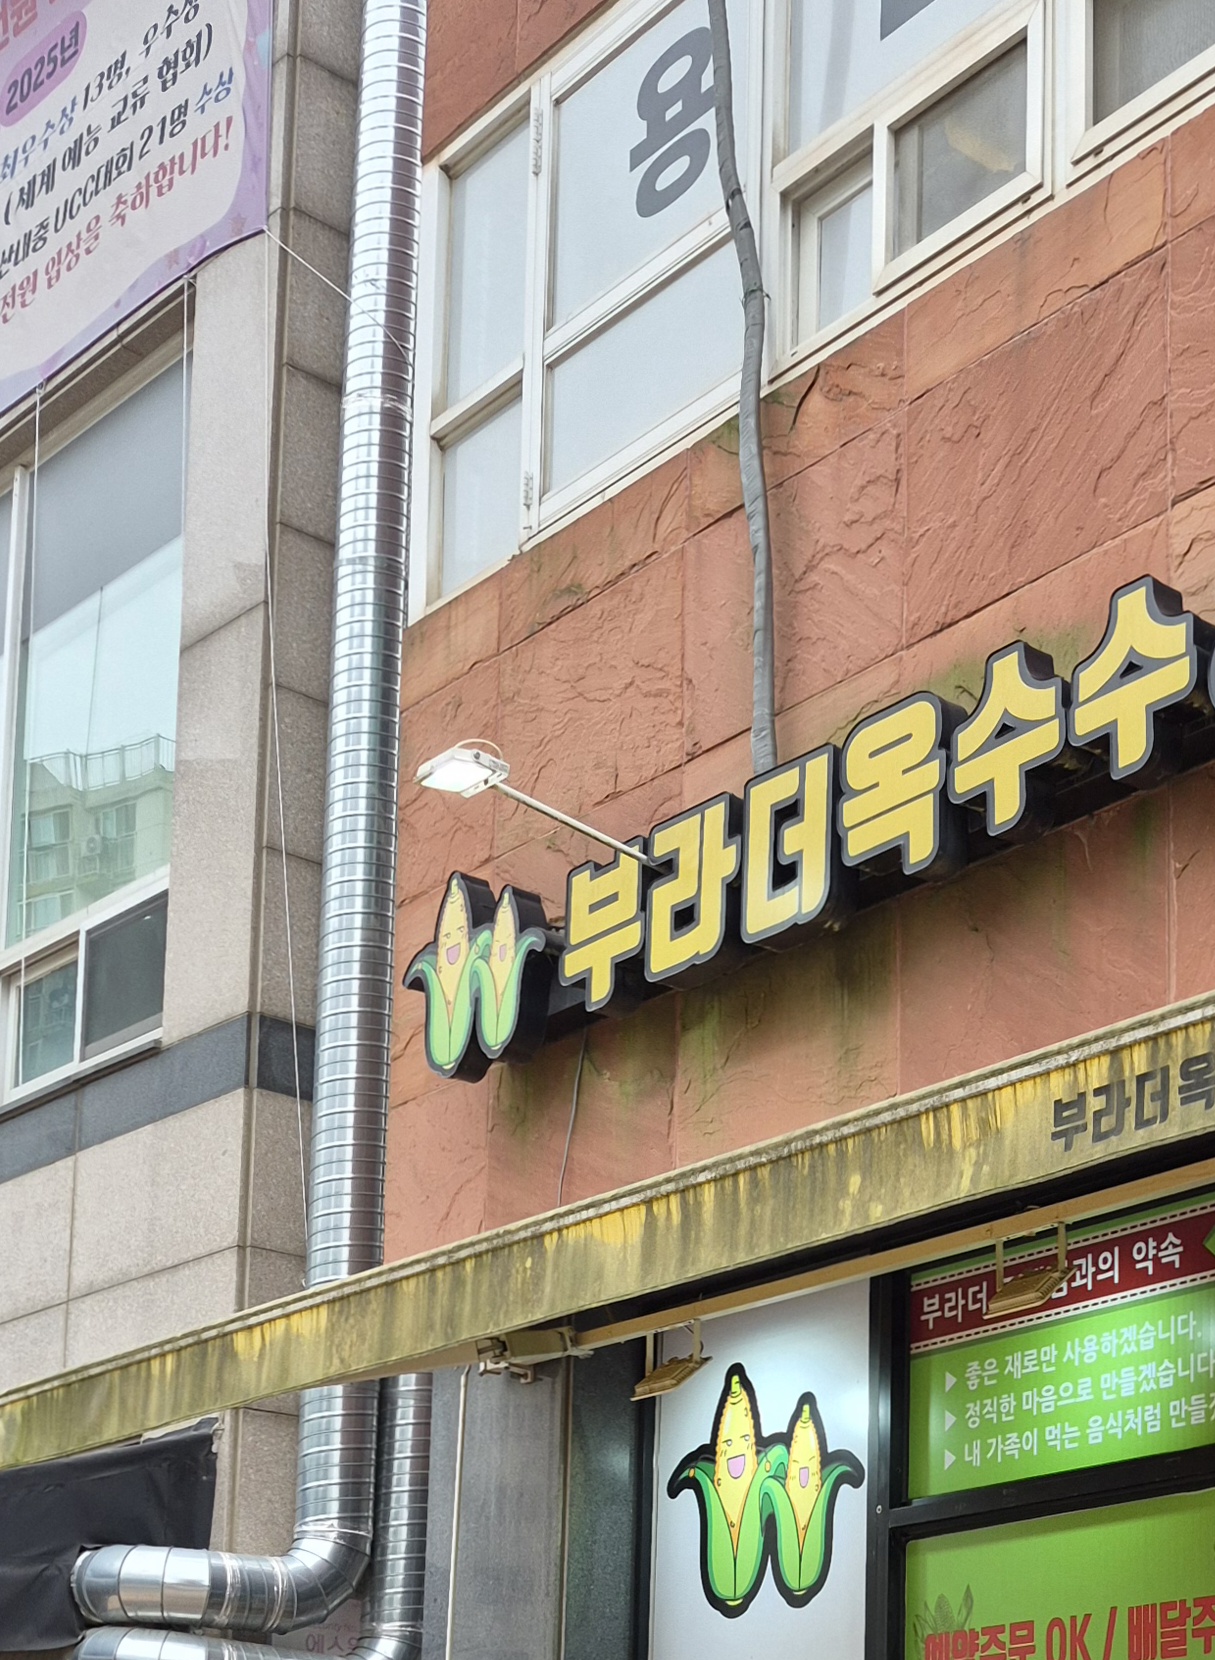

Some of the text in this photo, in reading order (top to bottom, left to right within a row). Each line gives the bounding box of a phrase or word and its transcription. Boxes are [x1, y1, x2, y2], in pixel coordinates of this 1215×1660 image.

[0, 95, 78, 183] 최우수상
[82, 49, 130, 112] 13명,
[5, 20, 80, 115] 2025년
[61, 122, 102, 172] 예능
[107, 75, 150, 133] 교류
[156, 22, 213, 93] 협회)
[54, 140, 134, 234] UCC대회
[138, 98, 190, 160] 21명
[193, 66, 235, 115] 수상
[0, 115, 234, 325] 전원 입상을 축하합니다!
[562, 578, 1195, 1005] 부라더옥수수
[920, 1281, 988, 1330] 부라더
[1132, 1232, 1184, 1276] 약속
[964, 1357, 999, 1390] 좋은
[1062, 1311, 1202, 1367] 사용하겠습니다.
[965, 1392, 1017, 1428] 정직한
[1022, 1377, 1093, 1416] 마음으로
[964, 1441, 981, 1467] 내
[986, 1429, 1039, 1463] 가족이
[1044, 1418, 1081, 1450] 먹는
[1086, 1403, 1162, 1443] 음식처럼
